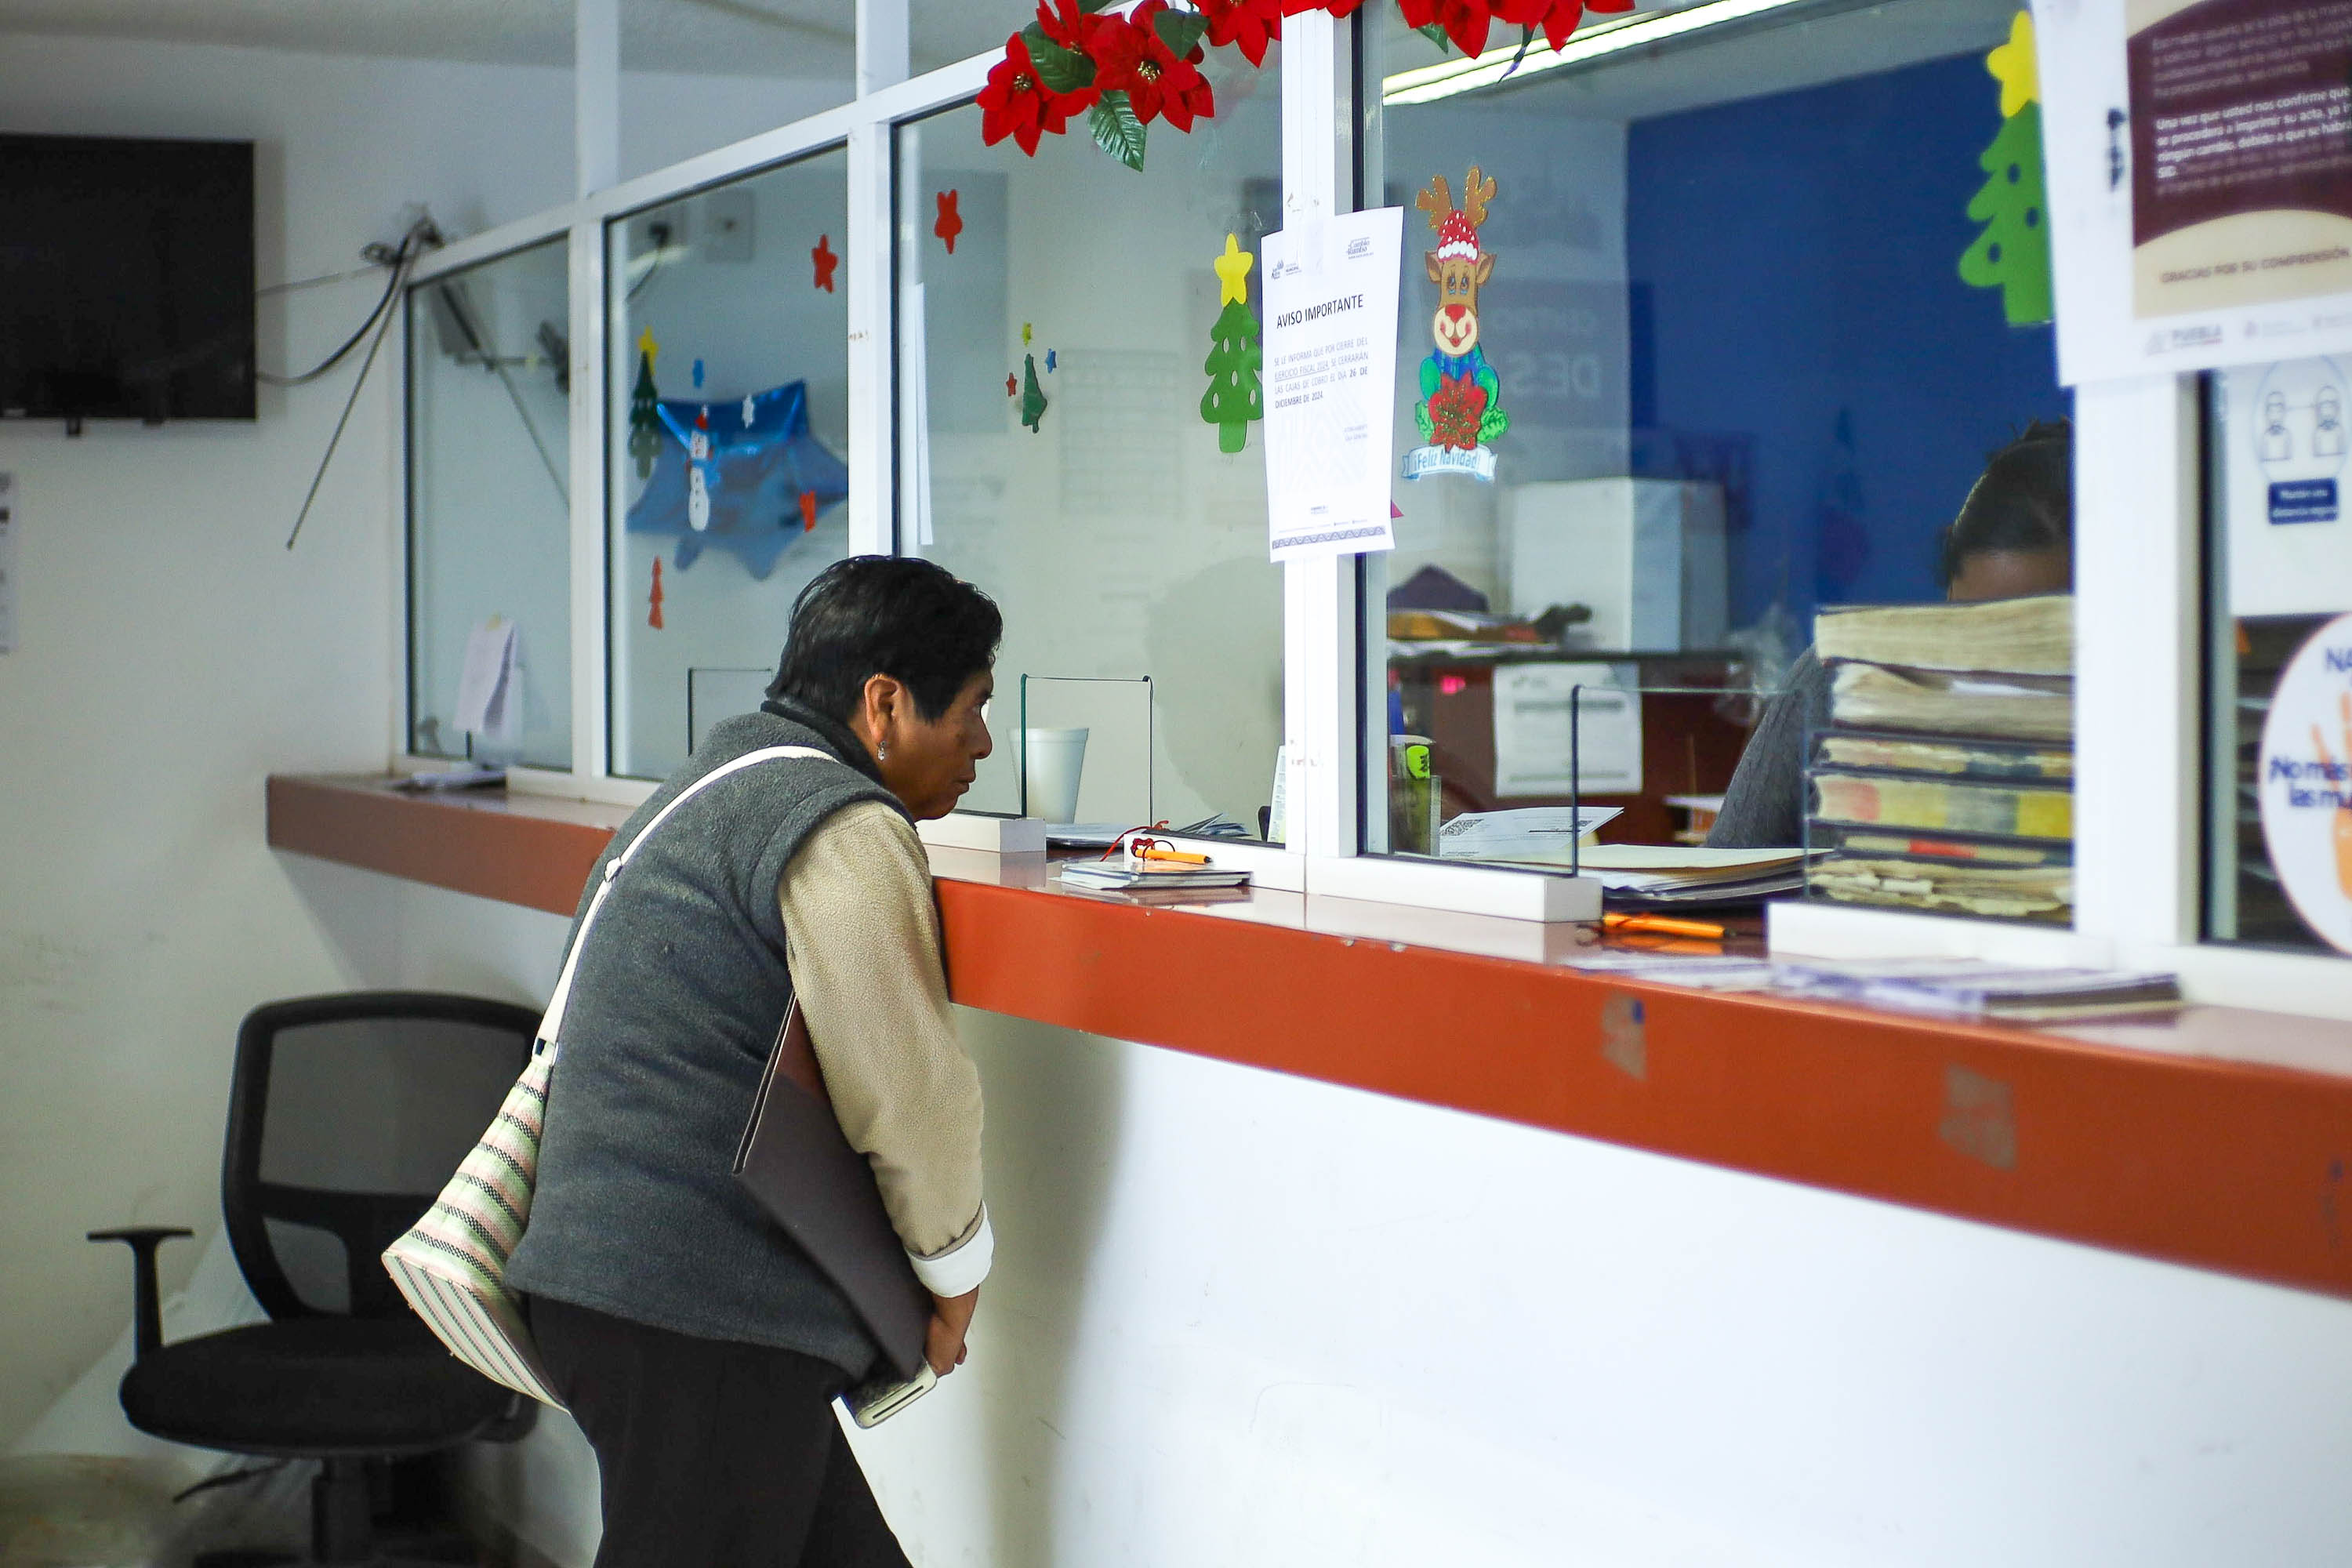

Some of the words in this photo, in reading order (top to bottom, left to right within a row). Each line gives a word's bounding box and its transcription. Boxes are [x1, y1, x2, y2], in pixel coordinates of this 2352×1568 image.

[2222, 103, 2253, 118] usted
[2276, 92, 2327, 108] confirme
[2328, 87, 2351, 100] que
[1276, 310, 1302, 329] AVISO
[1305, 293, 1364, 322] IMPORTANTE
[1274, 358, 1279, 367] SE
[1281, 355, 1287, 365] LE
[1288, 350, 1312, 363] INFORMA
[1313, 347, 1324, 358] QUE
[1325, 344, 1335, 354] POR
[1336, 339, 1354, 351] CIERRE
[1356, 336, 1368, 347] DEL
[1275, 385, 1283, 395] LAS
[1285, 381, 1301, 392] CAJAS
[1302, 379, 1310, 388] DE
[1311, 374, 1328, 387] COBRO
[1330, 373, 1336, 383] EL
[1349, 368, 1357, 378] 26
[1359, 365, 1368, 376] DE
[1300, 363, 1316, 375] FISCAL
[1275, 395, 1302, 409] DICIEMBRE
[1303, 394, 1310, 403] DE
